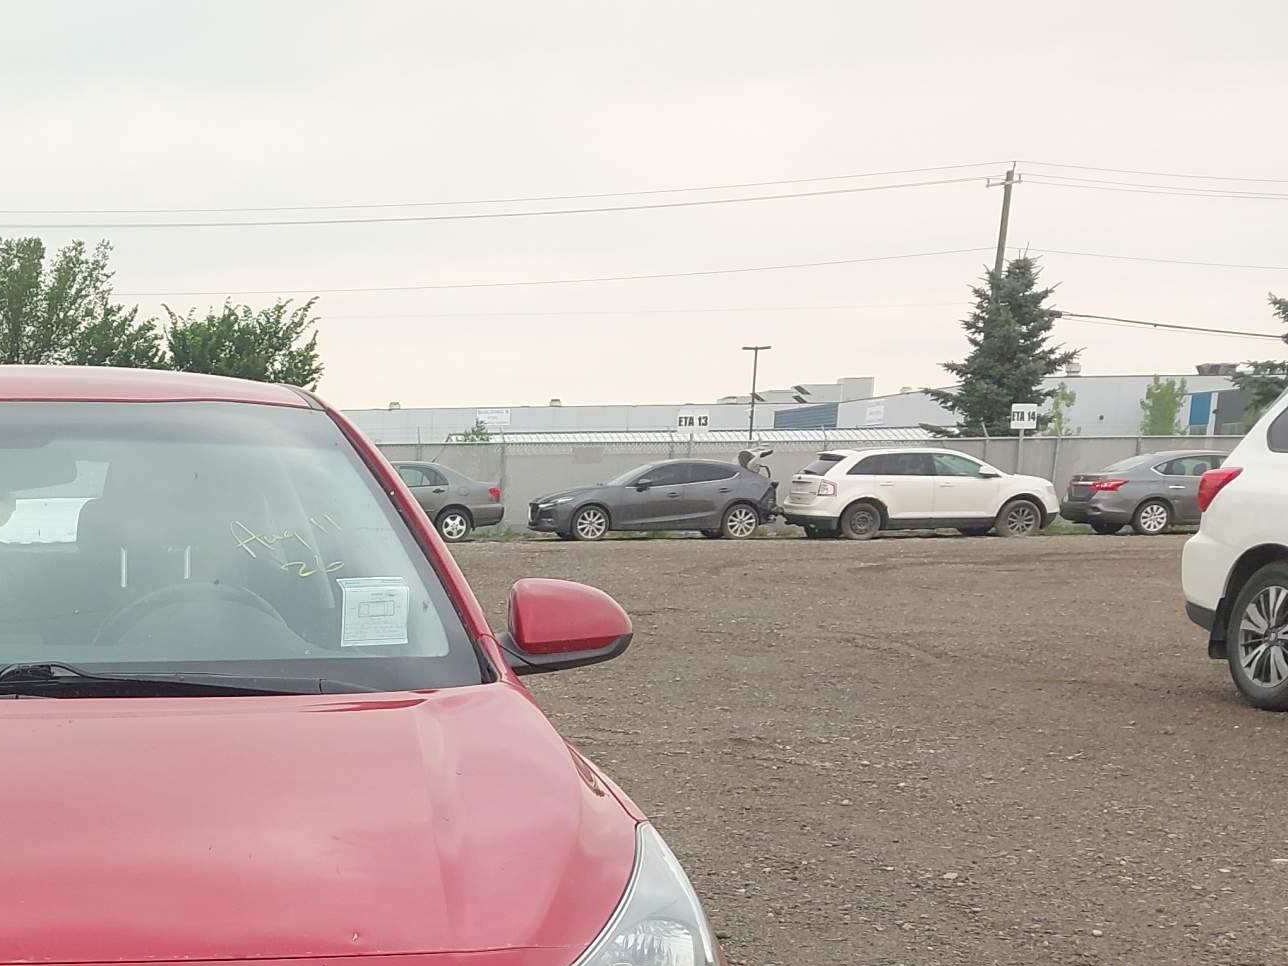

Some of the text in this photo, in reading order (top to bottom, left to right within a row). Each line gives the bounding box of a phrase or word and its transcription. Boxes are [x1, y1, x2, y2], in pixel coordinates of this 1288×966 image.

[678, 415, 709, 427] ETA 13
[1012, 410, 1036, 422] ETA 14
